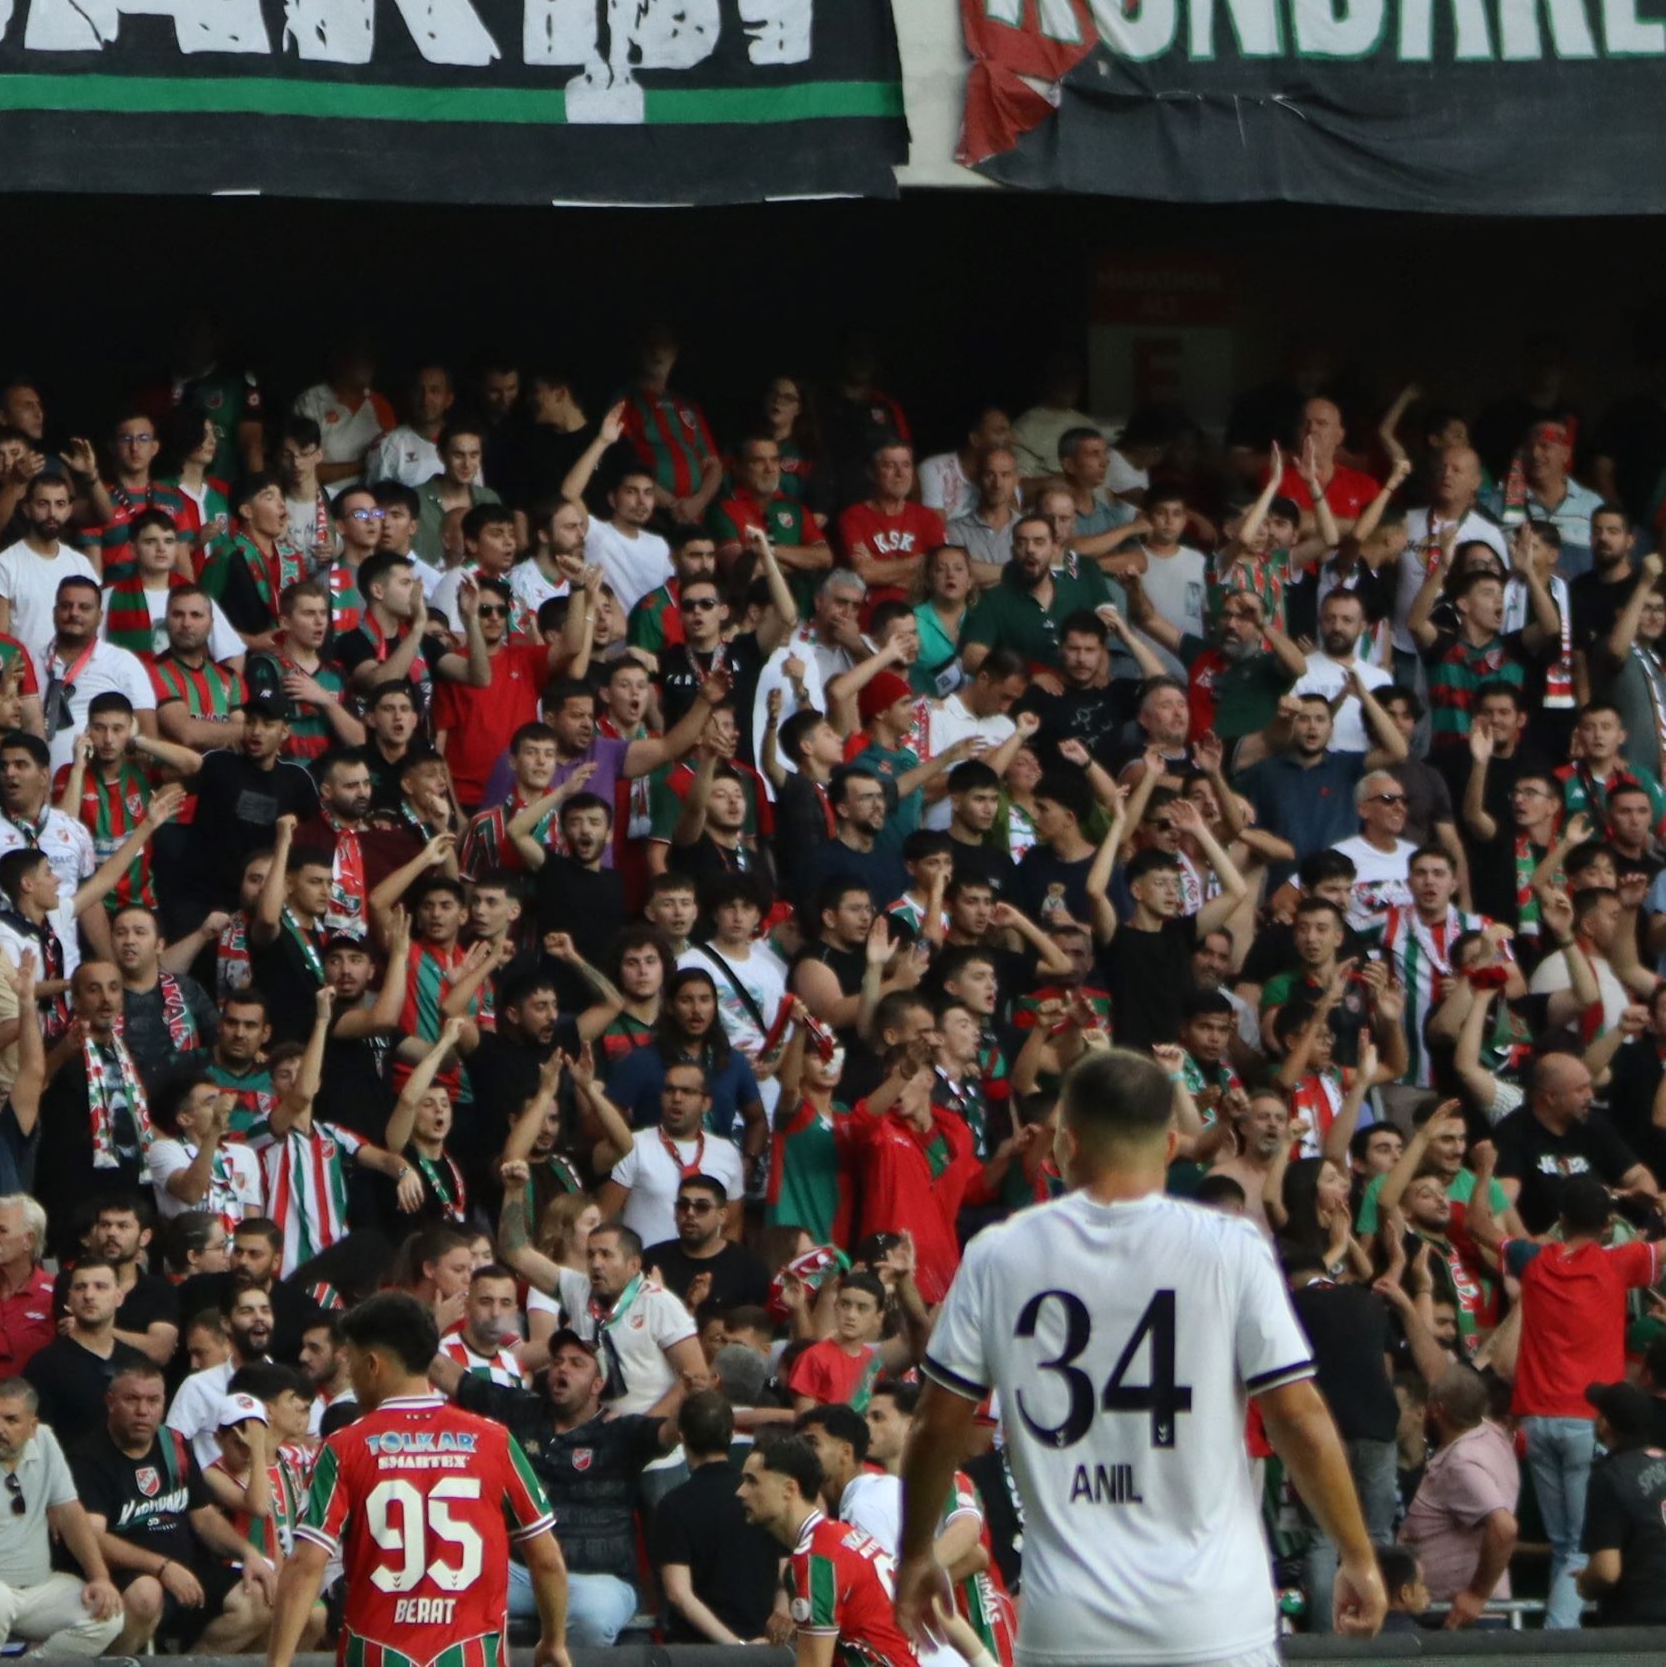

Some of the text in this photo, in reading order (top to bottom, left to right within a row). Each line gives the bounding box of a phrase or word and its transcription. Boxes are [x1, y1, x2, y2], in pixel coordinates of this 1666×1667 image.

[873, 529, 916, 555] KSK
[1013, 1288, 1193, 1449] 34
[364, 1431, 479, 1456] TOLKAR
[1069, 1463, 1144, 1505] ANIL
[365, 1476, 484, 1593] 95
[393, 1597, 457, 1625] BERAT
